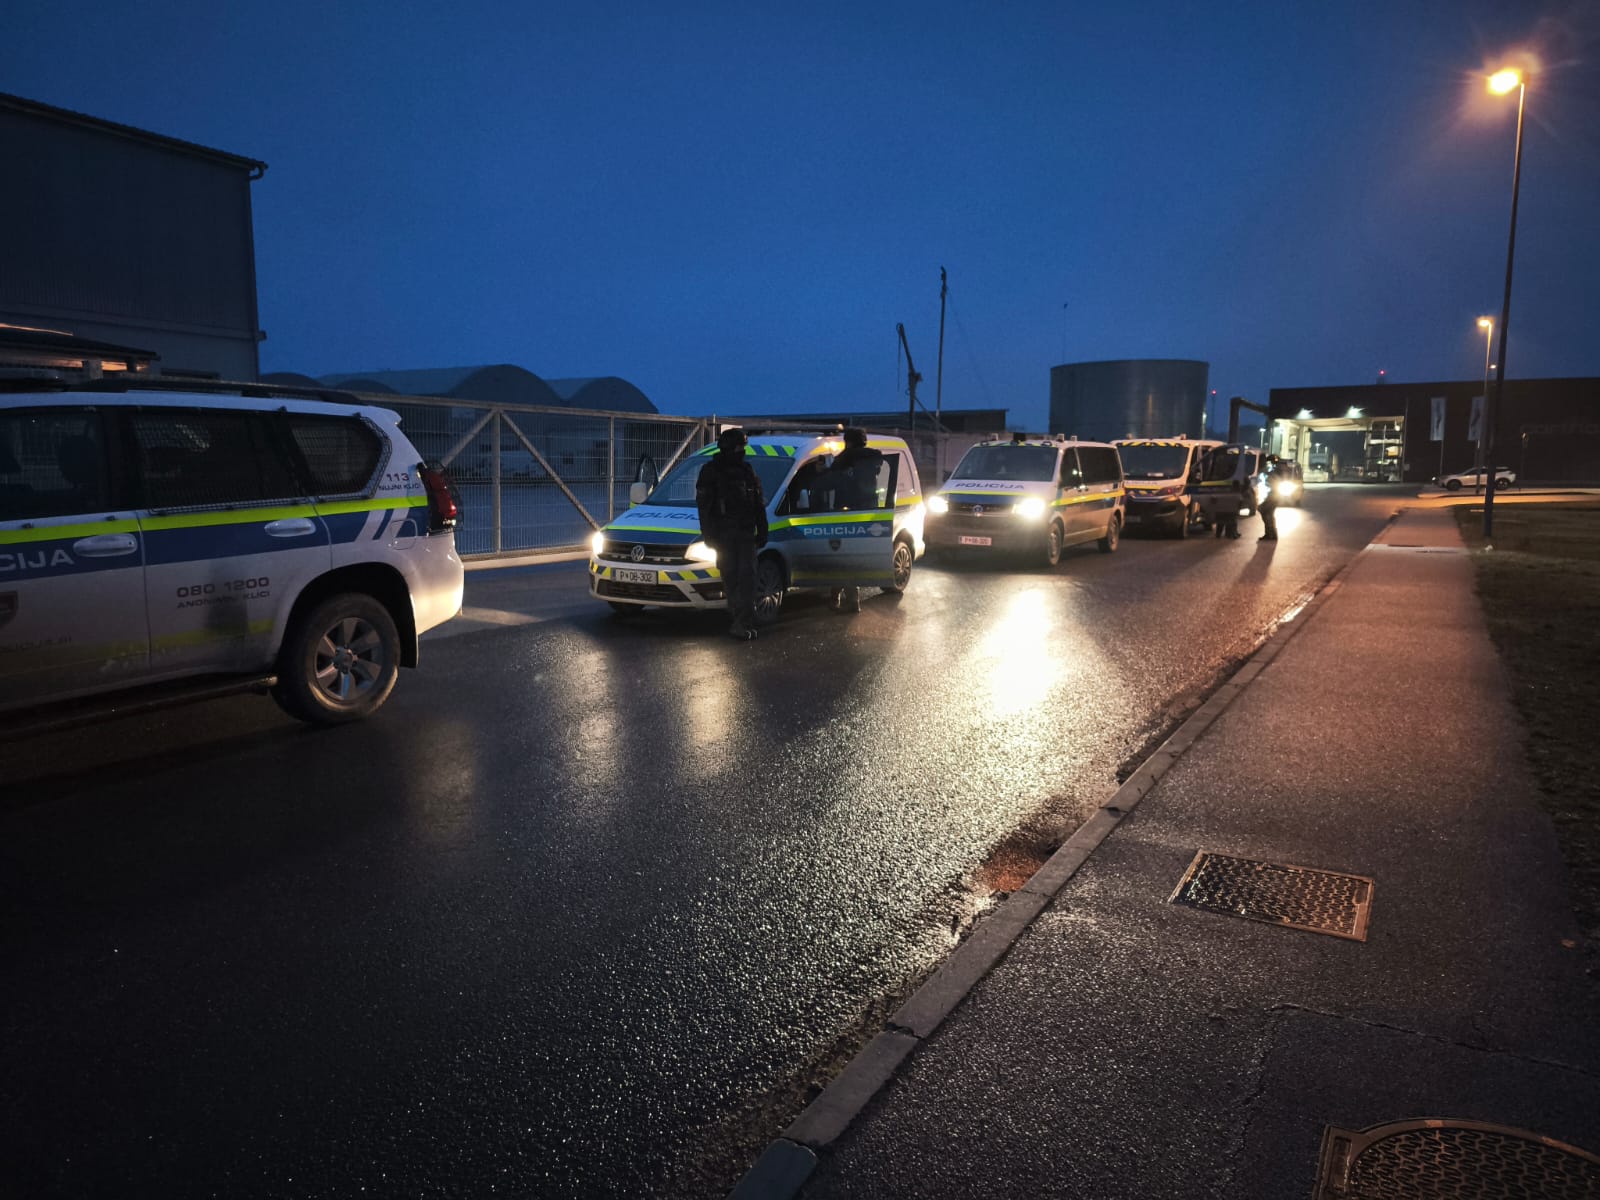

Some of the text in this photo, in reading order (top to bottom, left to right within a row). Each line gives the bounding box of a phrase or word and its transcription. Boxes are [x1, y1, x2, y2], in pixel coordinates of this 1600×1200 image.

[386, 473, 409, 482] 113
[803, 526, 866, 536] POLICIJA
[176, 576, 270, 598] 080 1200
